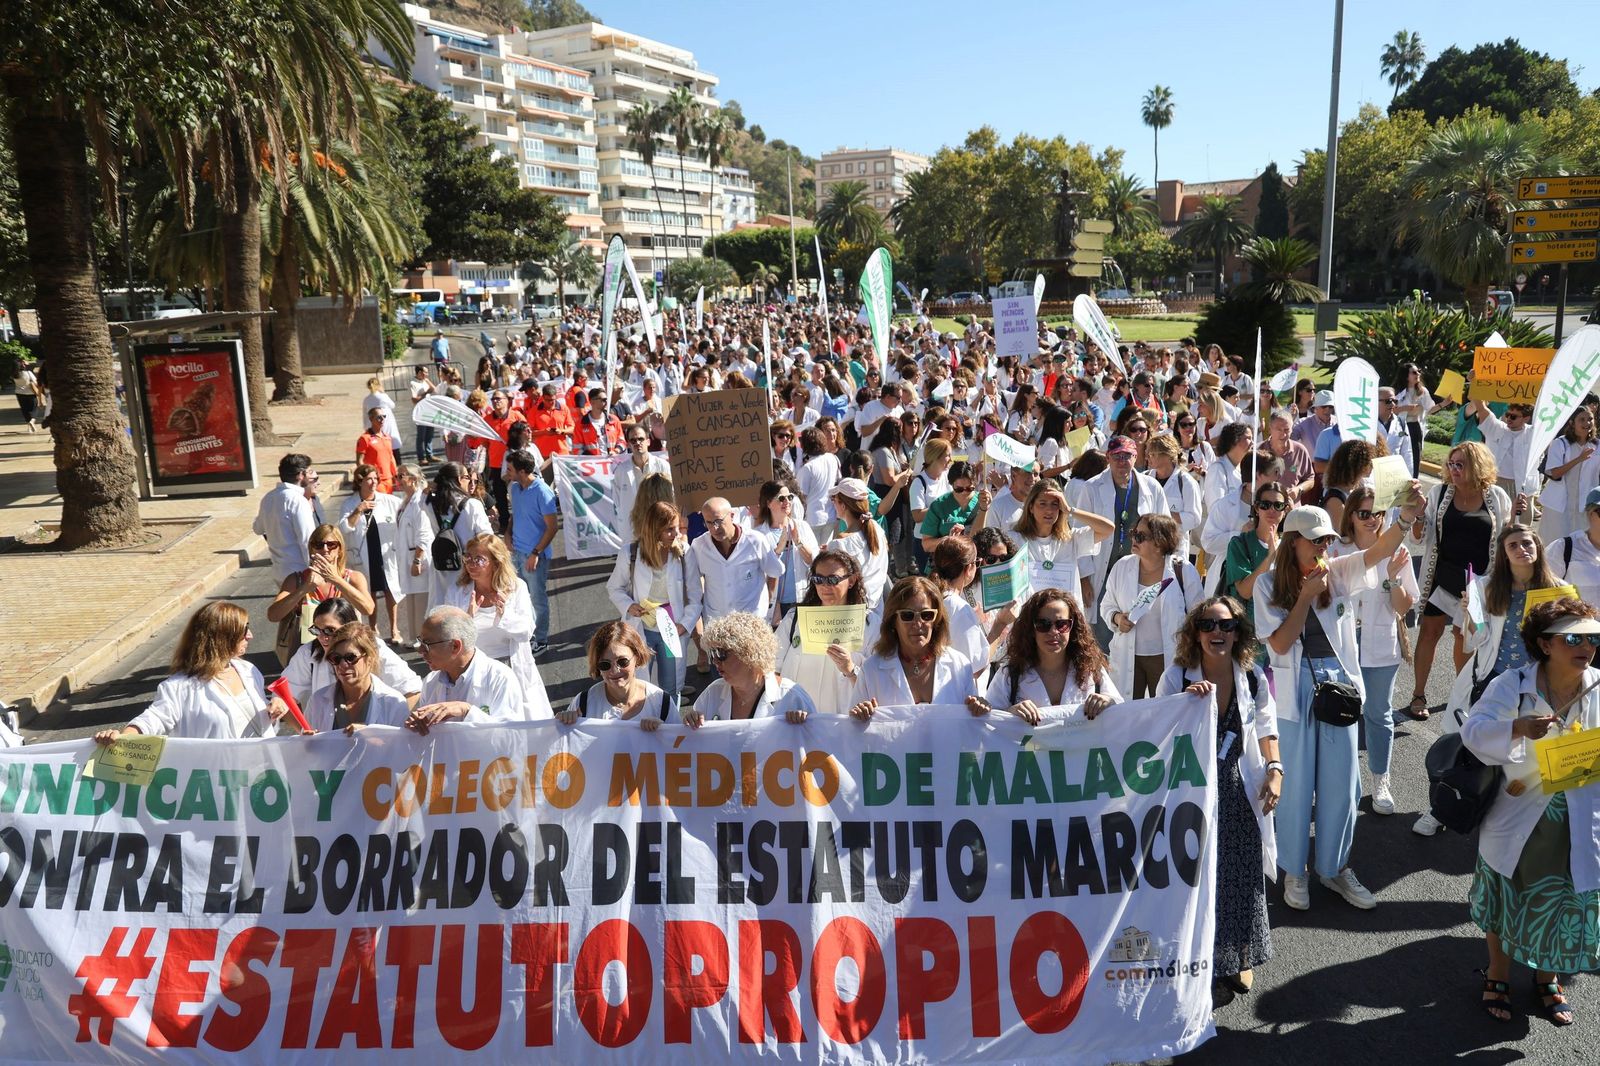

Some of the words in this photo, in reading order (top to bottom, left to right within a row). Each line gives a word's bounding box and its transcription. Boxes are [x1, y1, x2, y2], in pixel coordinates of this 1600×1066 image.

[1570, 219, 1598, 228] Norte
[1573, 250, 1595, 258] Este
[1479, 351, 1497, 363] NO
[1499, 350, 1514, 362] ES
[168, 362, 204, 377] nocilla
[1481, 364, 1497, 375] MI
[1476, 379, 1493, 387] ES
[697, 410, 762, 432] CANSADA
[174, 439, 223, 455] CRUJIENTES
[671, 444, 682, 457] DE
[750, 431, 762, 442] EL
[674, 455, 726, 478] TRAJE
[741, 450, 760, 469] 60
[680, 481, 708, 496] HORAS
[834, 626, 860, 634] SANIDAD
[108, 748, 118, 757] NO
[128, 751, 156, 761] SANIDAD
[0, 762, 291, 822] INDICATO
[308, 769, 346, 822] Y
[362, 752, 586, 821] COLEGIO
[607, 736, 839, 807] MÉDICO
[861, 751, 934, 806] DE
[956, 734, 1207, 806] MÁLAGA
[202, 834, 265, 914] EL
[283, 823, 570, 916] BORRADOR
[592, 821, 696, 905] DEL
[717, 819, 988, 906] ESTATUTO
[1010, 801, 1207, 900] MARCO
[68, 910, 1090, 1052] #ESTATUTOPROPIO
